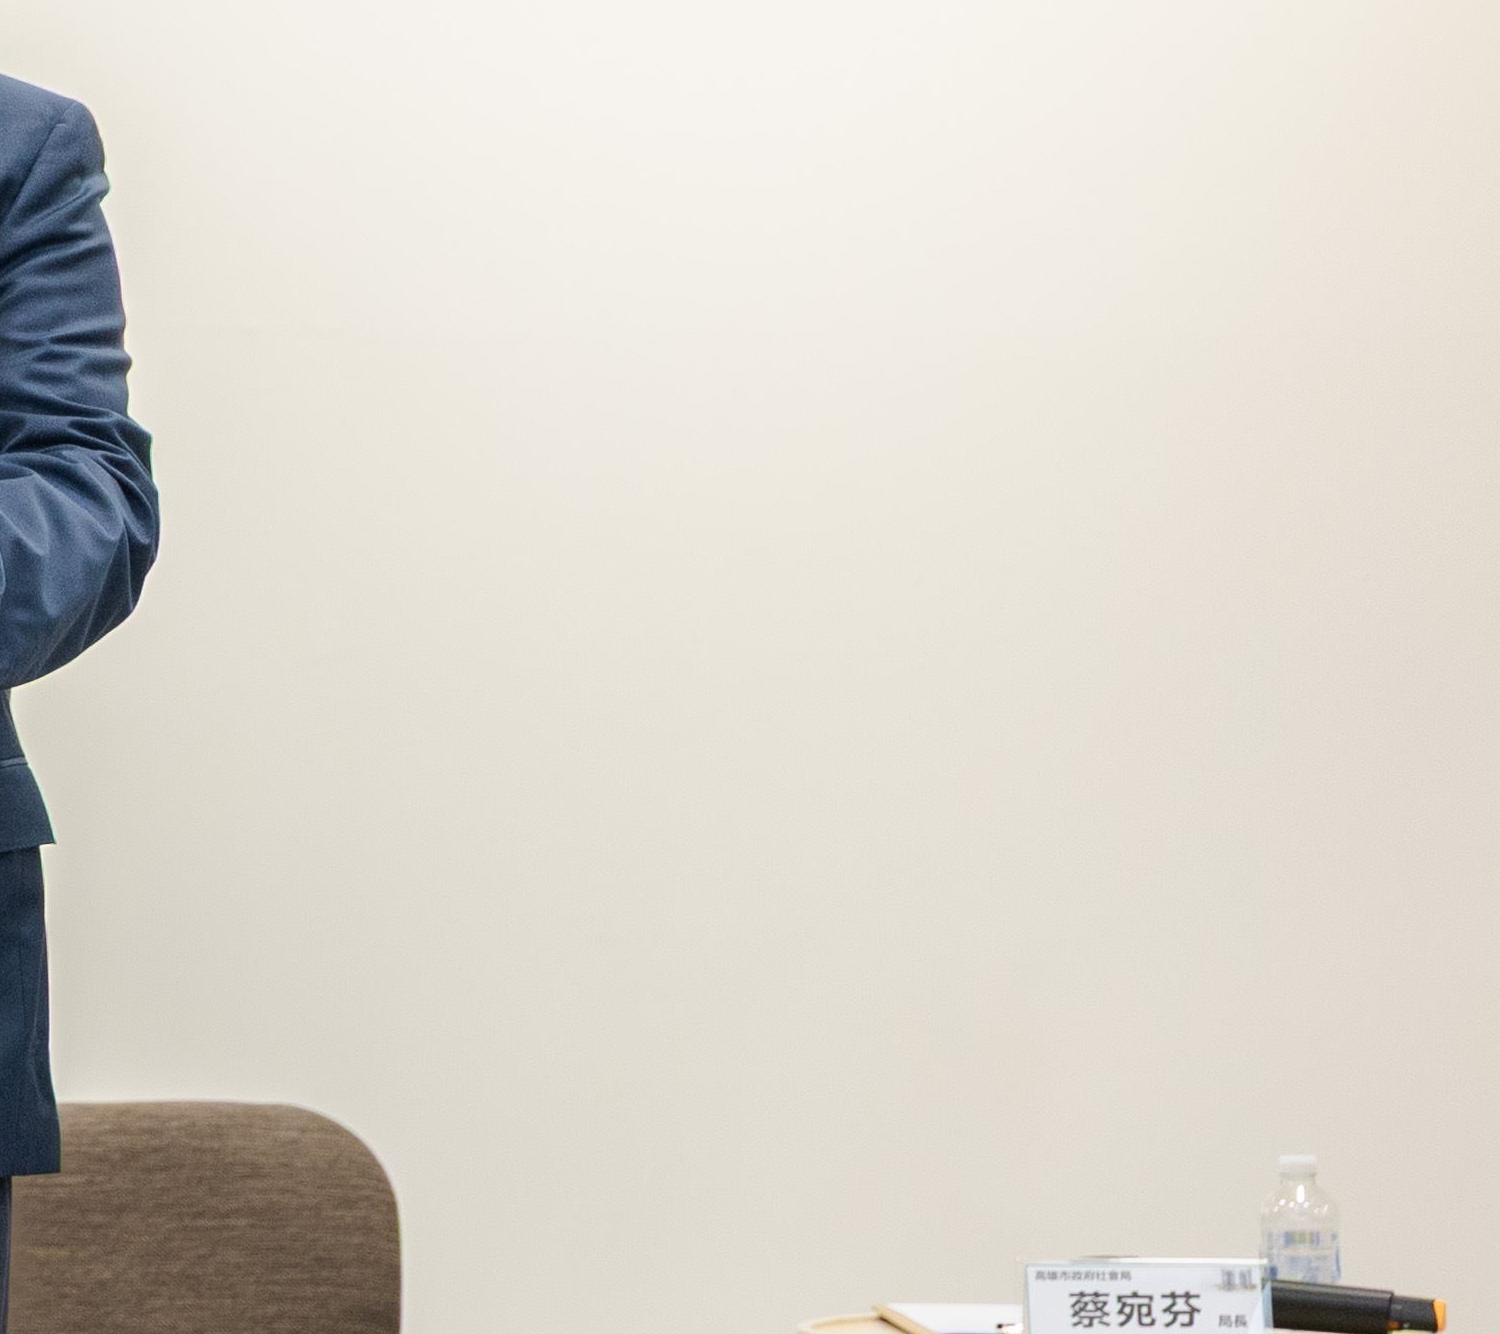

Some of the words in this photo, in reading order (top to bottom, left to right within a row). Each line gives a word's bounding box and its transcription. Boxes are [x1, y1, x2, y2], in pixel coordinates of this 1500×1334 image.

[1069, 1290, 1202, 1329] 蔡宛芬
[1218, 1314, 1248, 1328] 局長
